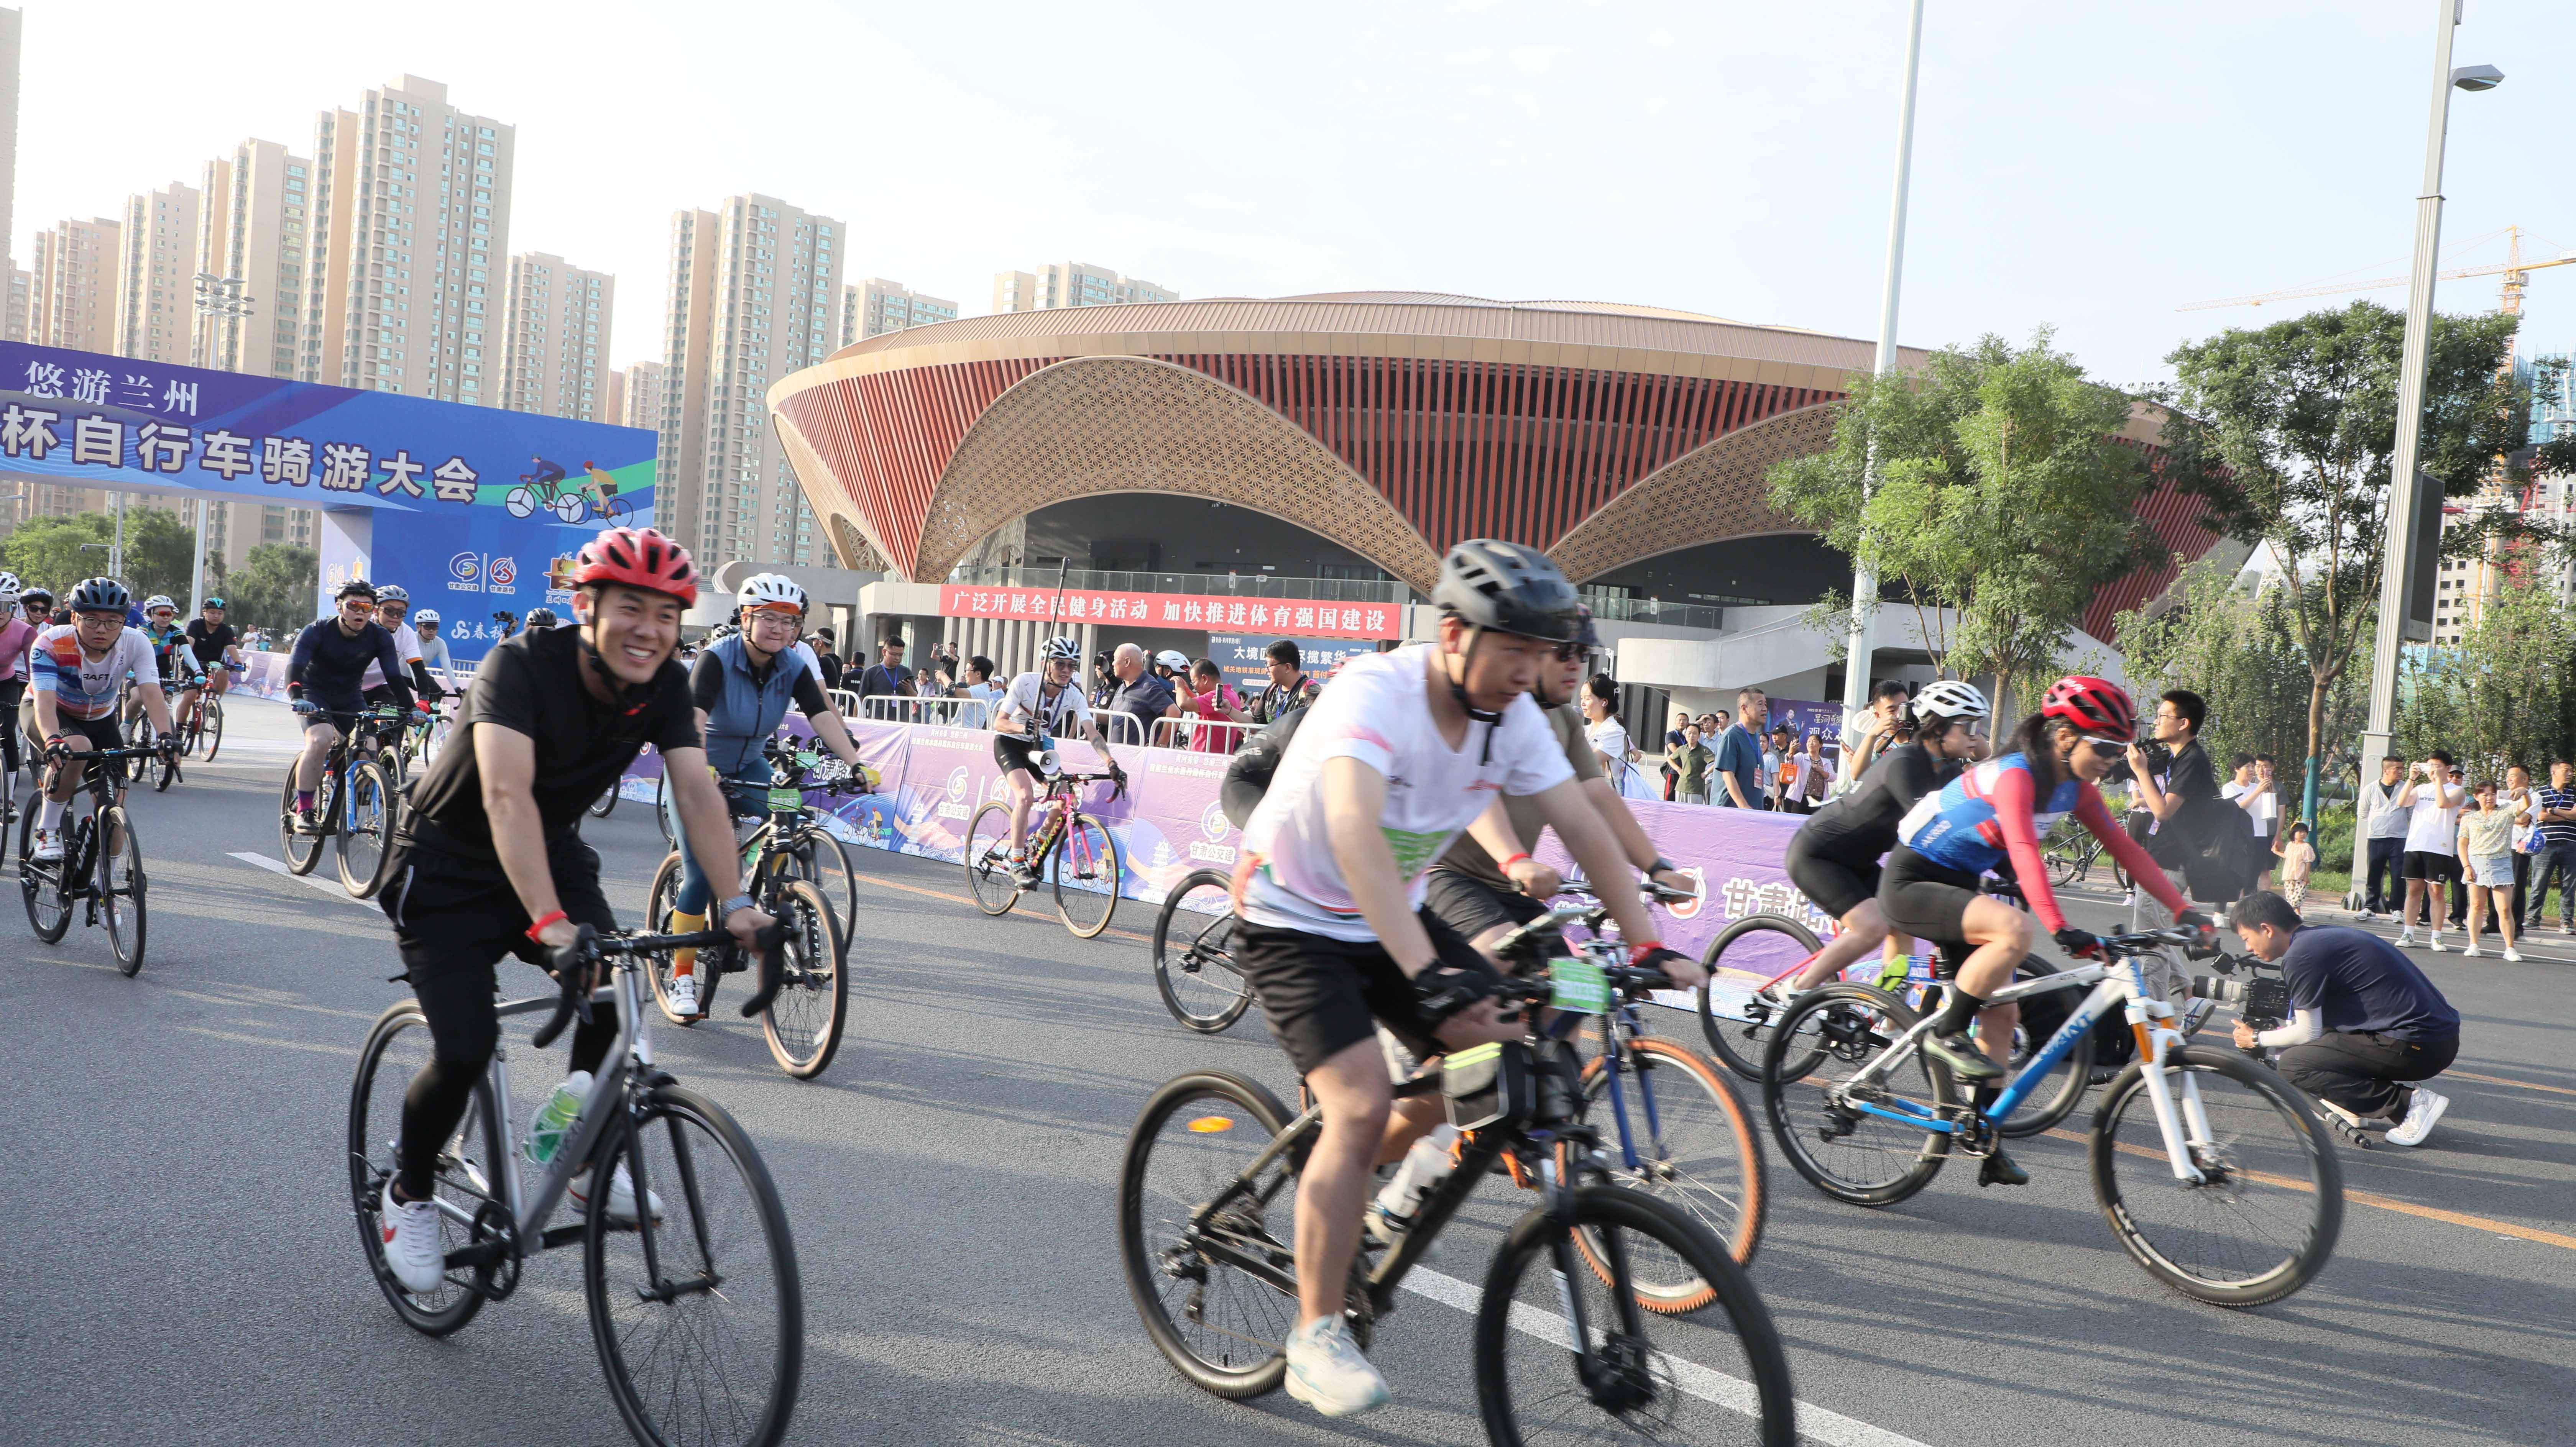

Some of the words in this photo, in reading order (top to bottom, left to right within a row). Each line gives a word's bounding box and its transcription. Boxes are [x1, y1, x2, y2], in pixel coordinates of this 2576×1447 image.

[24, 361, 199, 416] 悠游兰州
[1, 404, 478, 503] 杯自行车骑游大会
[448, 582, 479, 591] 甘肃公交建
[490, 585, 515, 594] 甘肃路桥
[952, 591, 1148, 620] 广泛开展全民健身活动
[1162, 600, 1385, 632] 加快推进体育强国建设
[1190, 842, 1235, 863] 甘肃公交建
